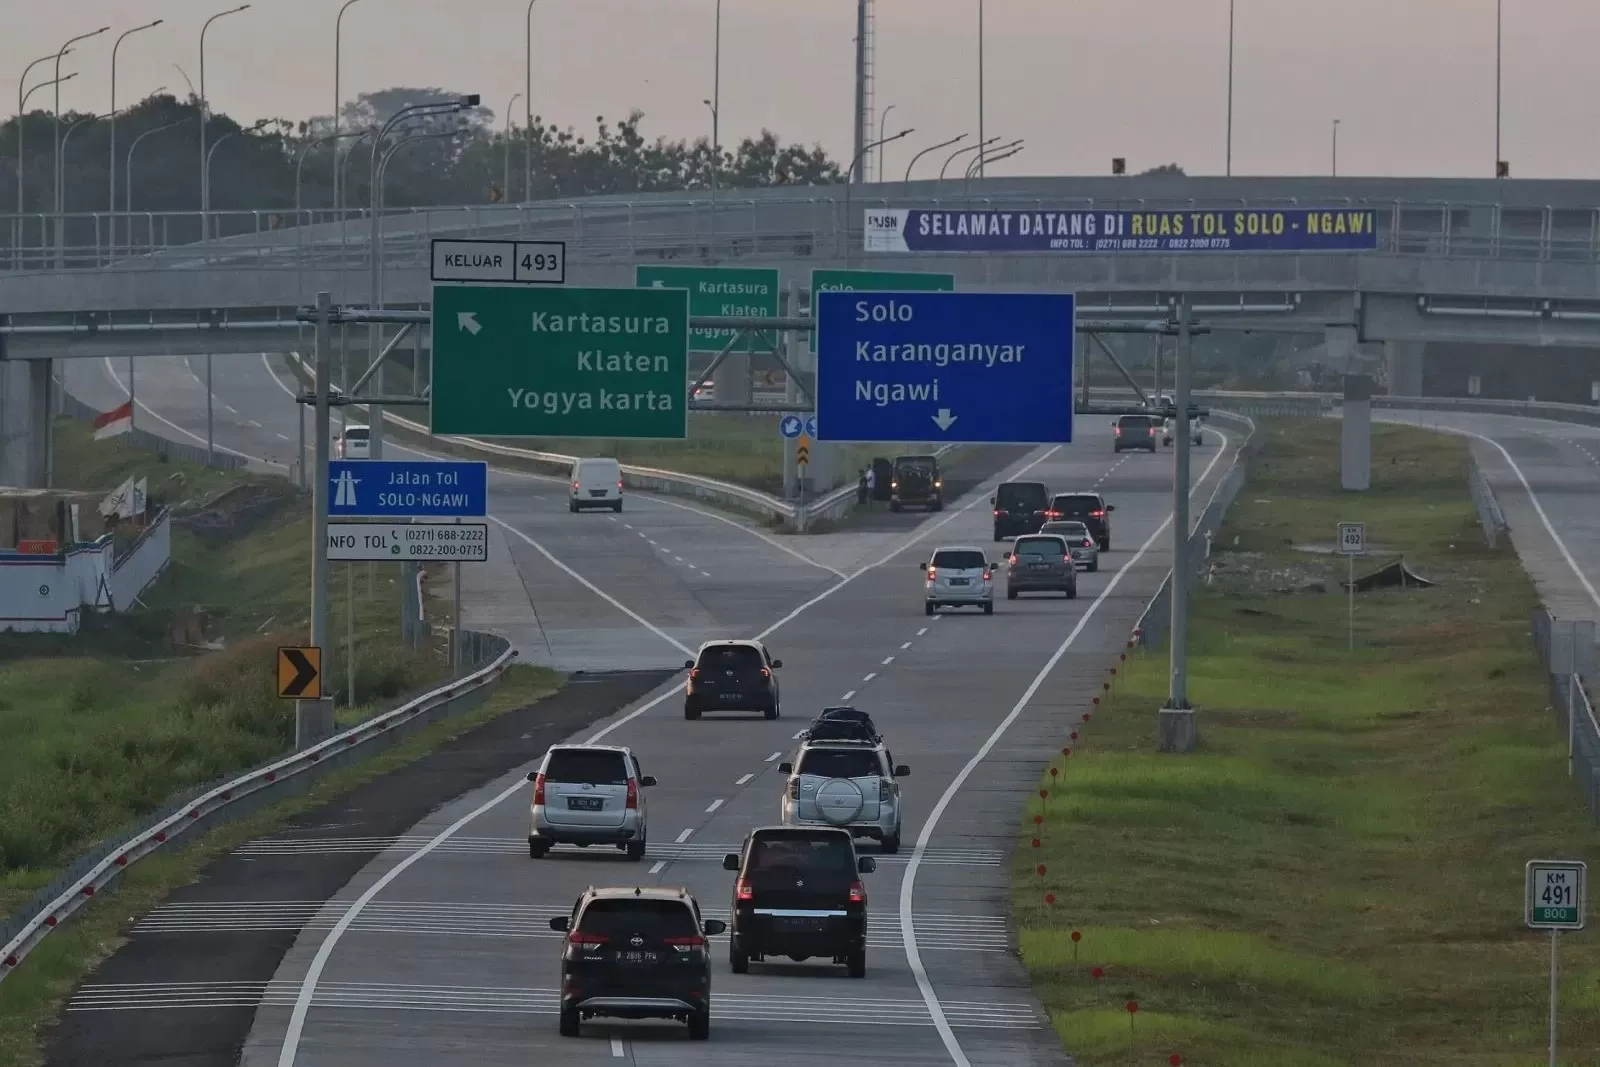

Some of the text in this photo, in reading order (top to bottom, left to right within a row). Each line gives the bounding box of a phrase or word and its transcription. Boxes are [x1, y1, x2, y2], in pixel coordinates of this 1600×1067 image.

[919, 213, 1012, 235] SELAMAT
[1020, 213, 1096, 235] DATANG
[1104, 213, 1123, 235] DI
[1132, 213, 1184, 235] RUAS
[1191, 213, 1227, 235] TOL
[1234, 212, 1284, 235] SOLO
[1307, 212, 1373, 234] NGAWI
[1050, 238, 1069, 249] INFO
[1095, 238, 1120, 250] (0271)
[1138, 238, 1158, 249] 2222
[445, 253, 558, 271] KELUAR 493
[699, 280, 768, 295] Kartasura
[721, 303, 768, 317] Klaten
[855, 300, 913, 322] Solo
[531, 311, 670, 334] Kartasura
[577, 350, 670, 372] Klaten
[855, 340, 1025, 367] Karanganyar
[855, 378, 939, 407] Ngawi
[388, 471, 459, 486] Jalan Tol
[378, 493, 469, 507] SOLO-NGAWI
[364, 535, 388, 549] TOL
[405, 529, 483, 542] (0271) 688-2222
[1344, 534, 1360, 544] 492
[409, 544, 483, 556] 0822-200-0775
[1547, 872, 1565, 884] KM
[1542, 885, 1571, 905] 491
[1544, 908, 1567, 919] 800
